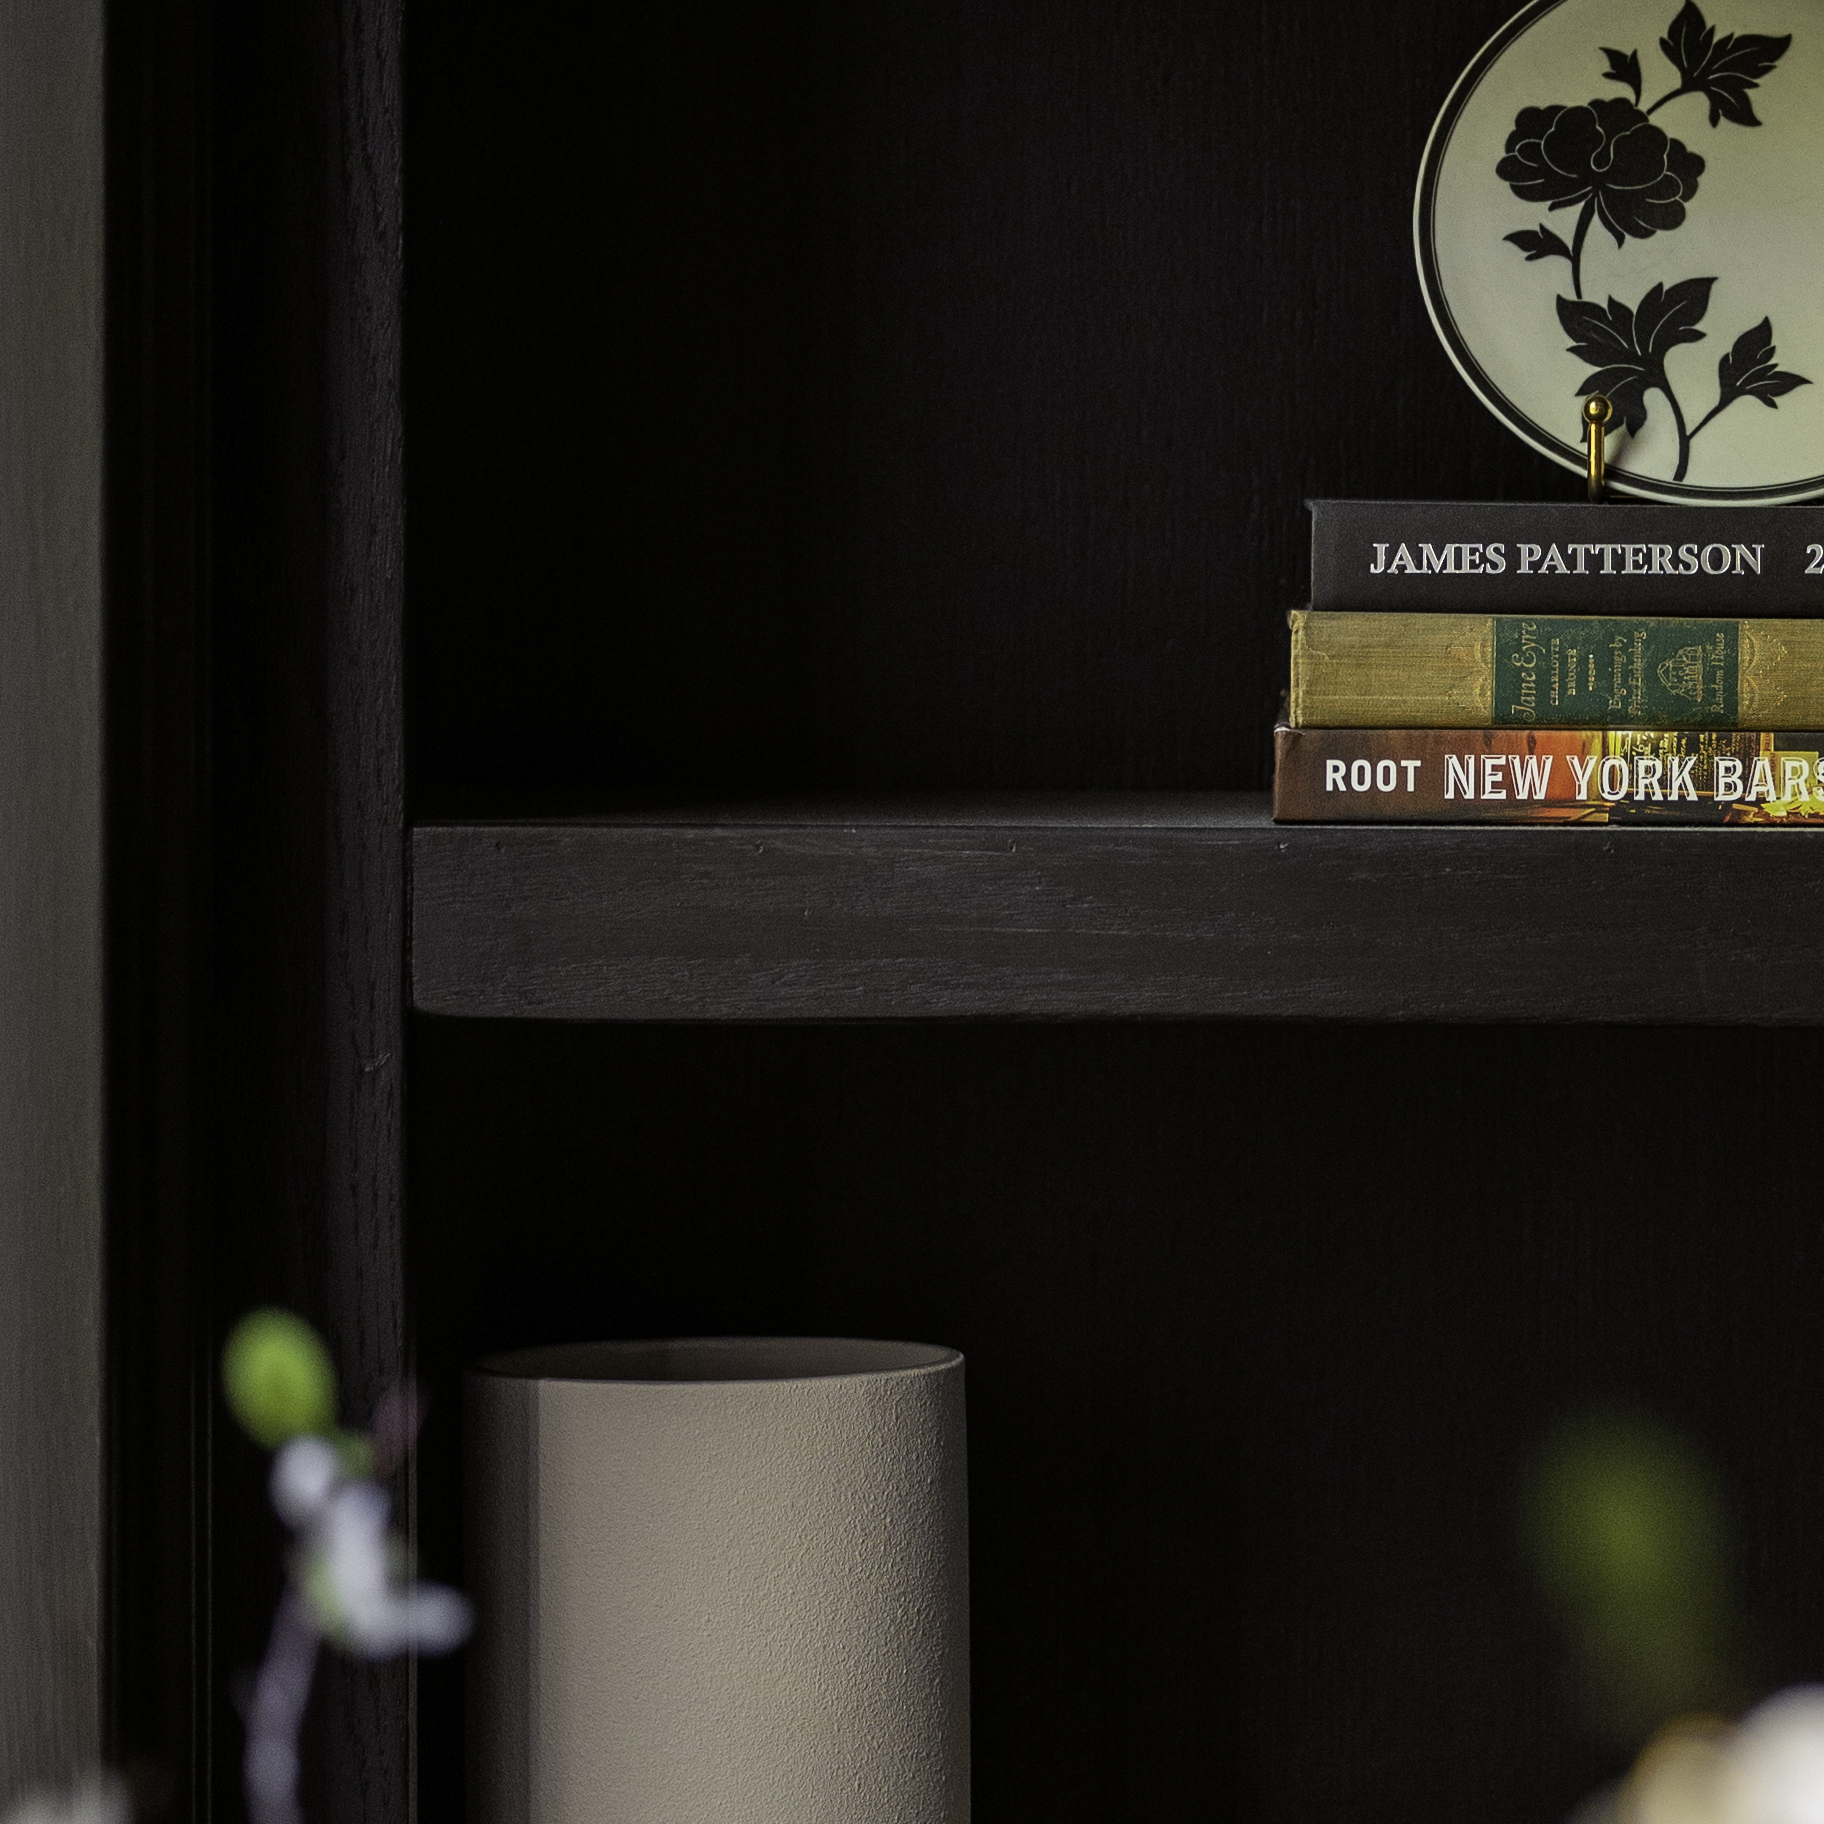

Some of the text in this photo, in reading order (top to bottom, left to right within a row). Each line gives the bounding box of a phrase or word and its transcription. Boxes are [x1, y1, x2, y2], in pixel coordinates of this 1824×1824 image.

[1369, 543, 1765, 575] JAMES PATTERSON
[1511, 622, 1546, 722] Jane Eyre
[1550, 638, 1560, 705] CHARLOTTE
[1325, 759, 1421, 792] ROOT
[1443, 754, 1553, 800] NEW
[1566, 755, 1699, 801] YORK
